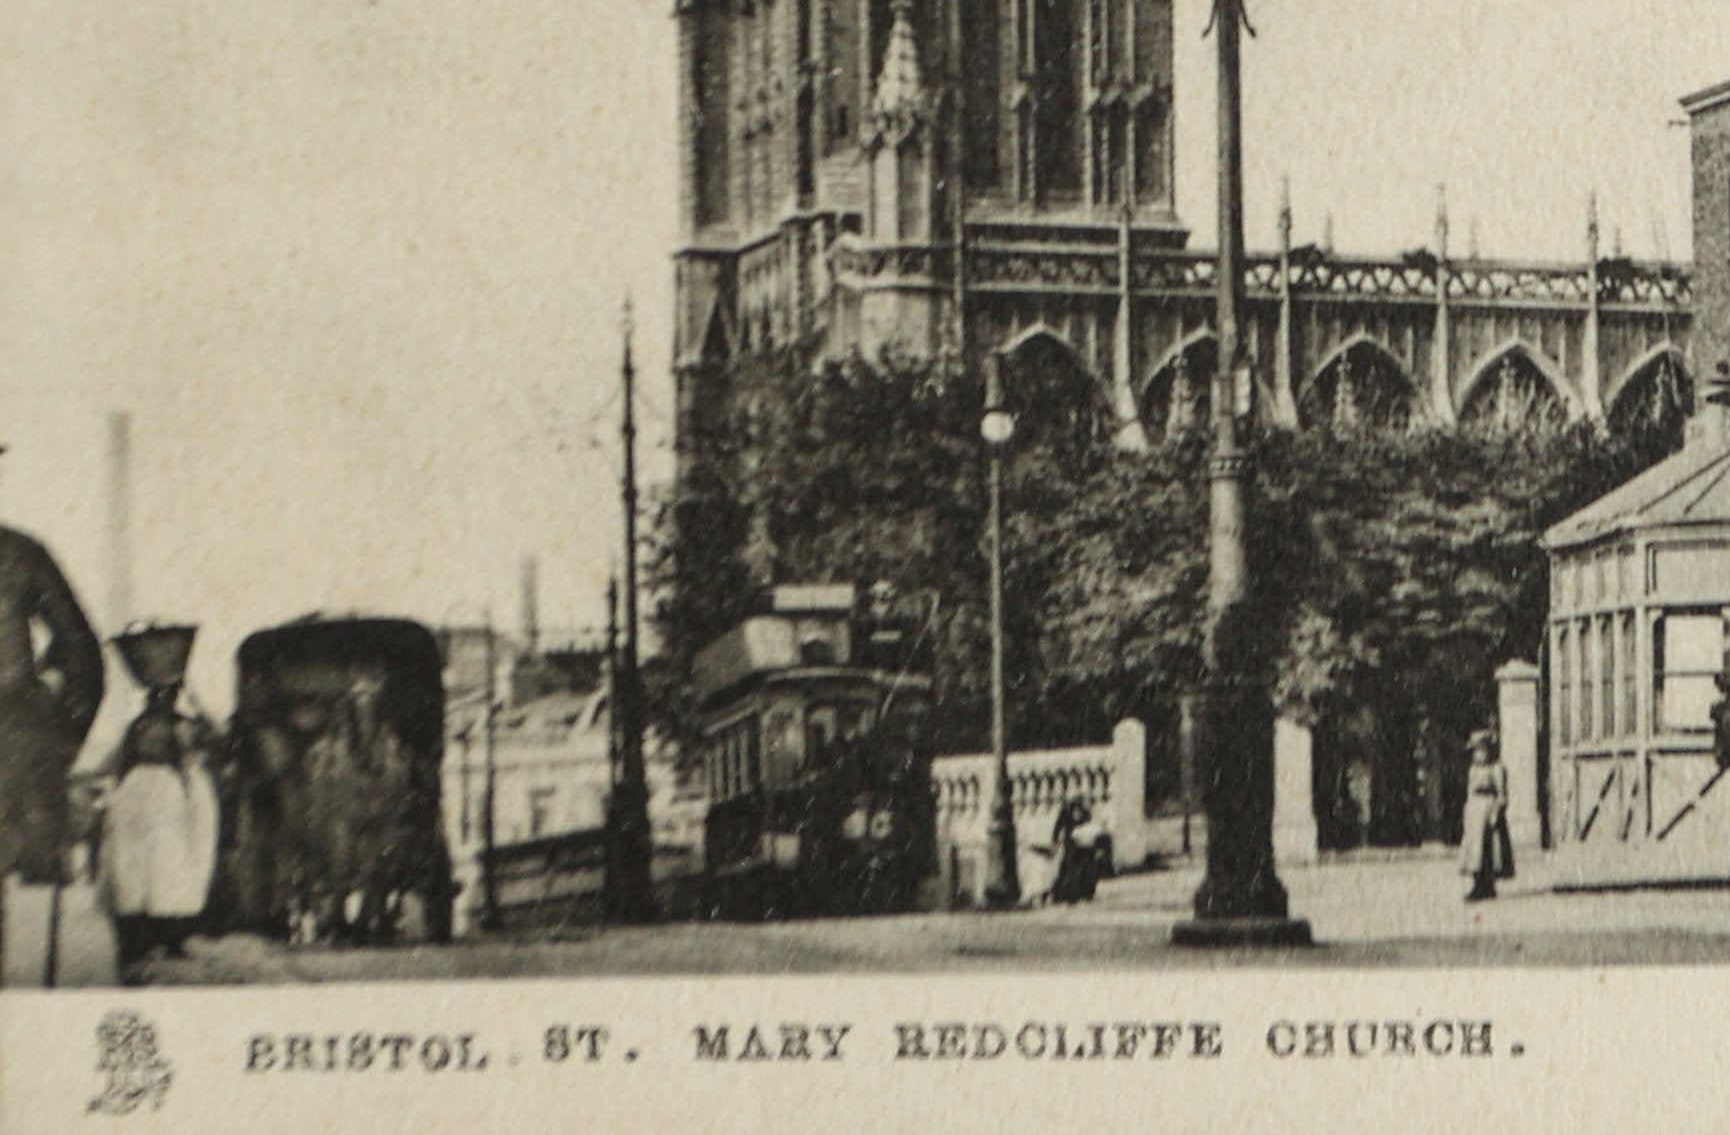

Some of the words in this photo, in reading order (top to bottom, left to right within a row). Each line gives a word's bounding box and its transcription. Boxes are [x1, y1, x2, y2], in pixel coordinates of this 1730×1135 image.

[541, 1025, 639, 1065] ST.
[691, 1022, 853, 1063] MARY
[894, 1020, 1223, 1061] REDCLIFFE
[1264, 1018, 1527, 1060] CHURCH.
